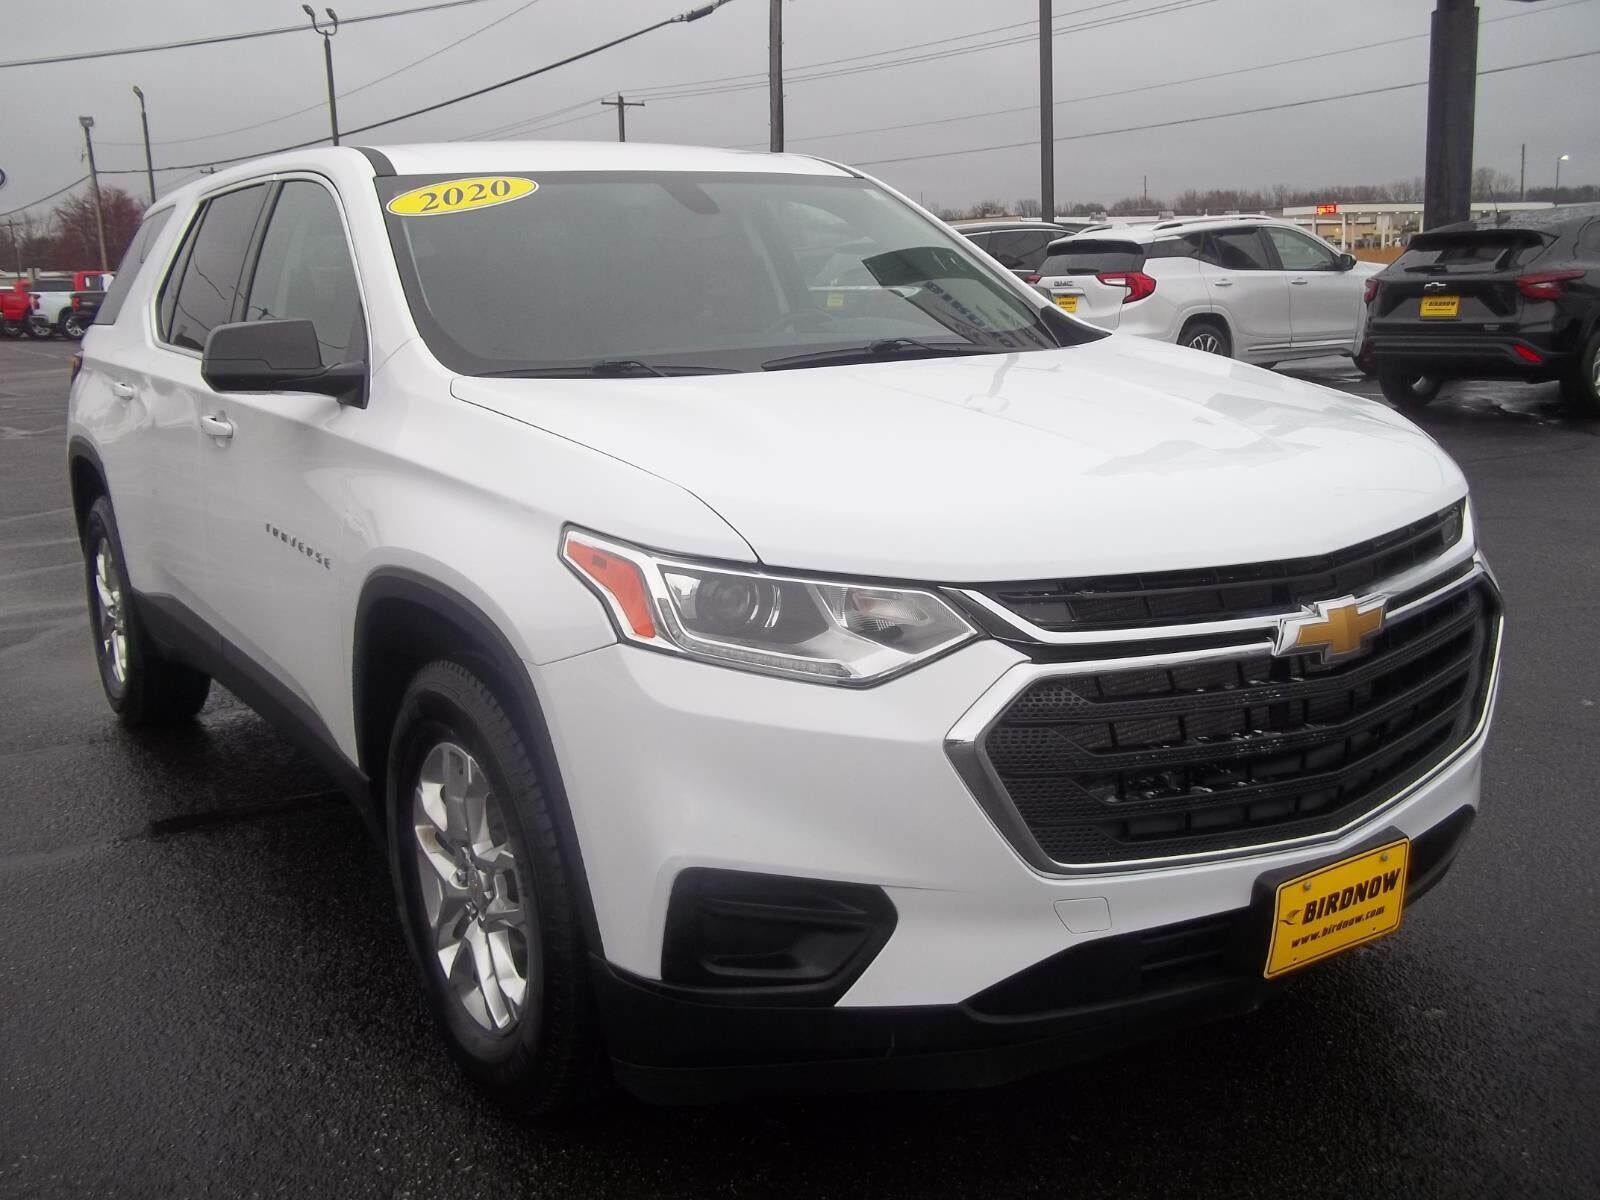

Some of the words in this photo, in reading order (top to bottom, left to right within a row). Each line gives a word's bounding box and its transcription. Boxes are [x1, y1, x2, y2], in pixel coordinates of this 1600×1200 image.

[419, 179, 511, 212] 2020
[1301, 867, 1402, 926] BIRDNOW
[1291, 905, 1386, 949] www.birdnow.com
